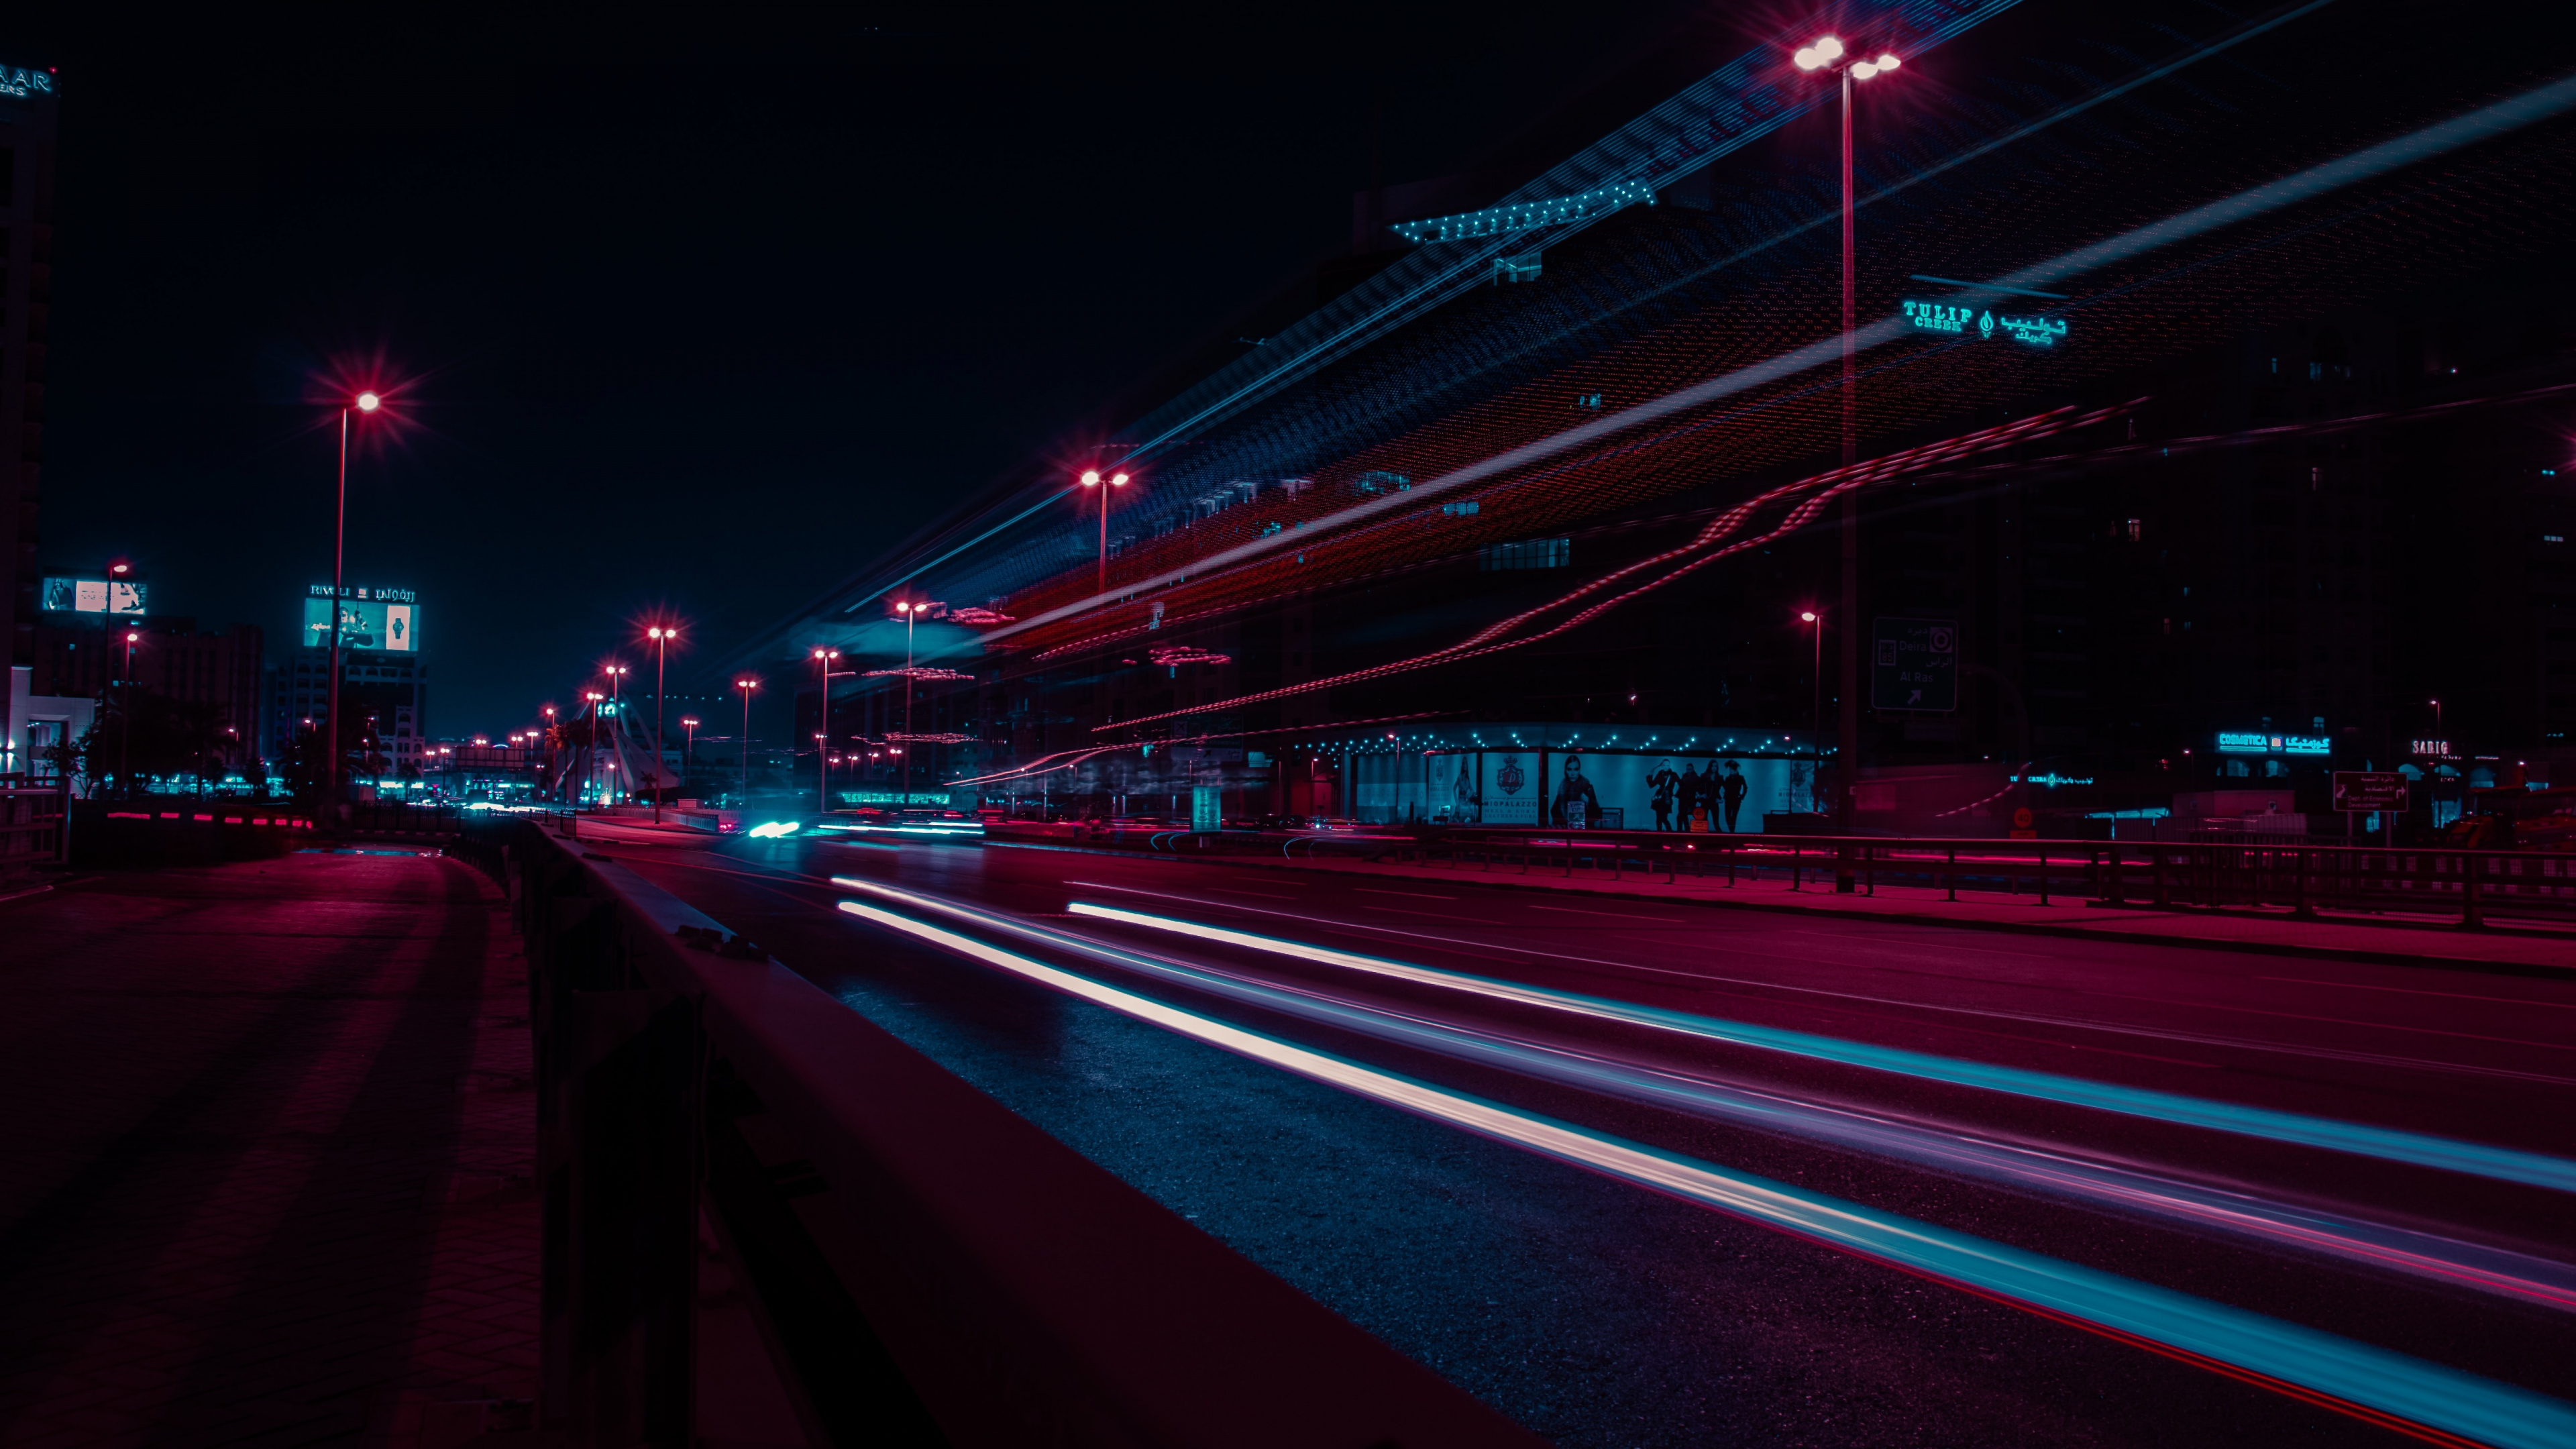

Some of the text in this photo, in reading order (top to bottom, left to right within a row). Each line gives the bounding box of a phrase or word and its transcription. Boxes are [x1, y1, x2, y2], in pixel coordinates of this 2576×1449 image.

[1903, 301, 1972, 323] TULIP
[1915, 316, 1962, 331] CREEK
[1899, 640, 1927, 651] Deira
[1900, 672, 1934, 682] Al Ras
[2219, 734, 2267, 745] COSMETICA
